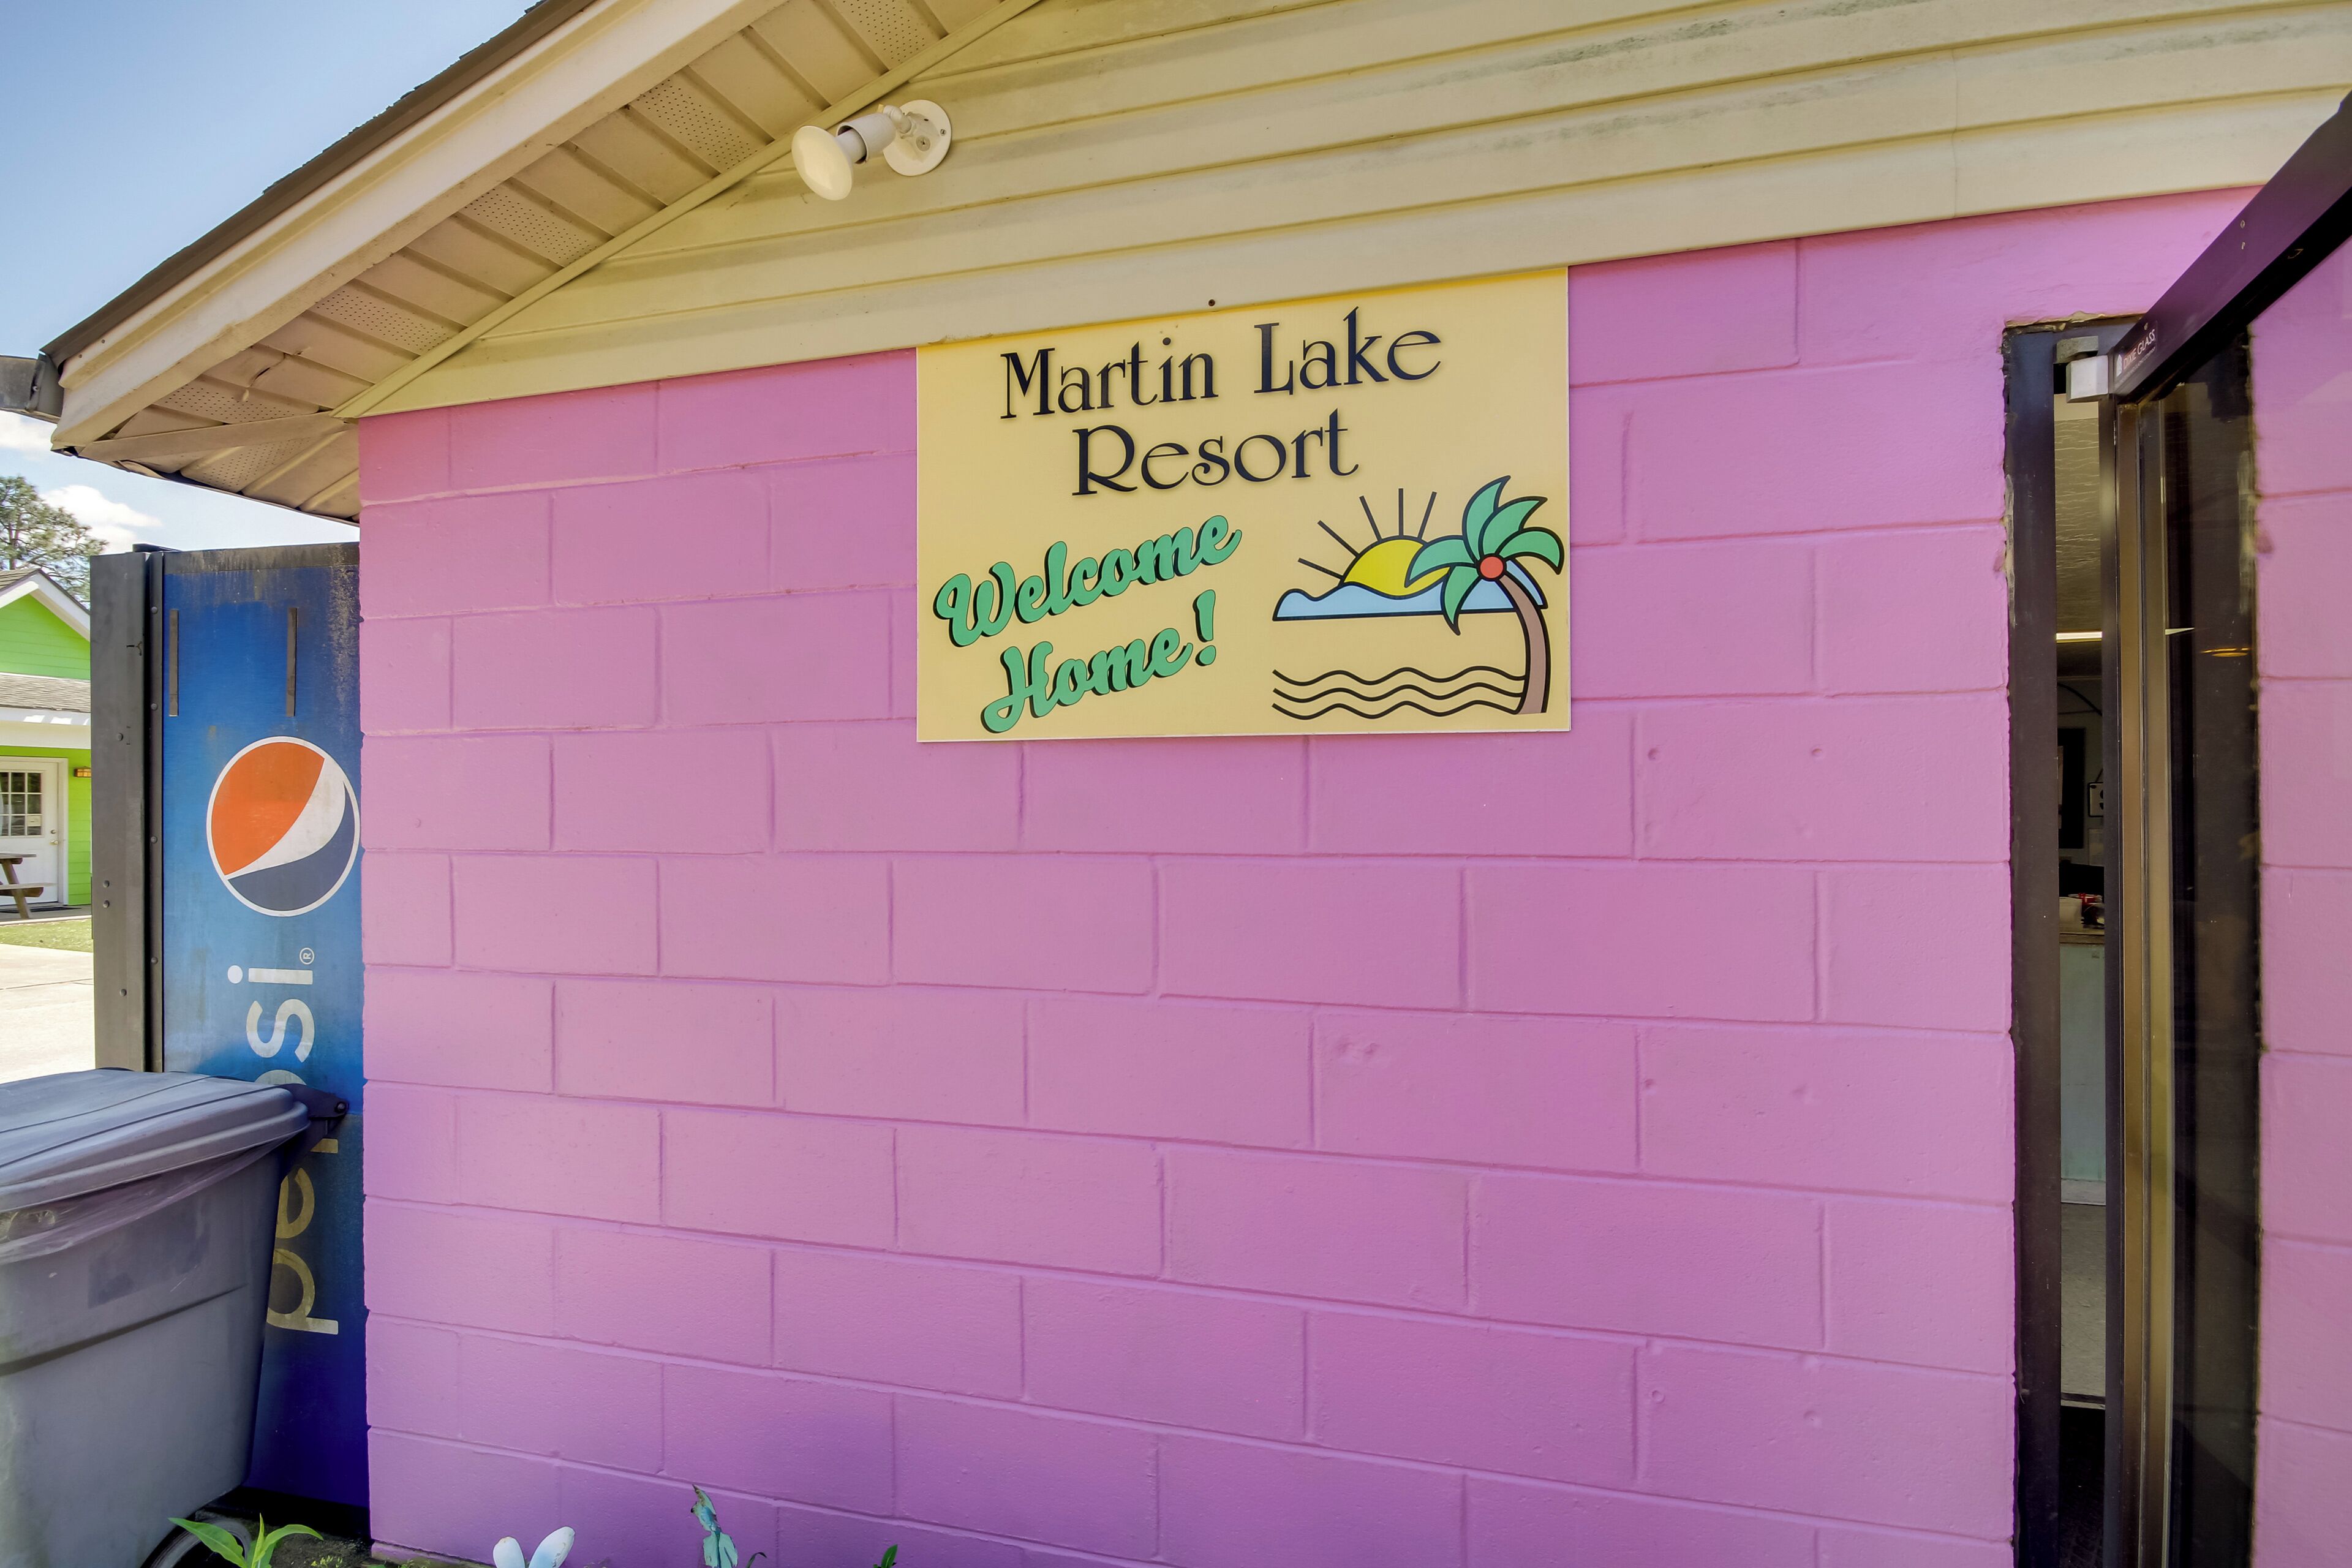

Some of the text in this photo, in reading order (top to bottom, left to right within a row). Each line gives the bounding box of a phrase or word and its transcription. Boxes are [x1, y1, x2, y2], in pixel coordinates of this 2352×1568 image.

[1000, 306, 1442, 420] Martin Lake
[2137, 328, 2155, 355] GLASS
[1072, 408, 1360, 496] Resort
[933, 514, 1242, 647] Welcome
[981, 589, 1218, 733] Home!
[227, 965, 339, 1335] pesi
